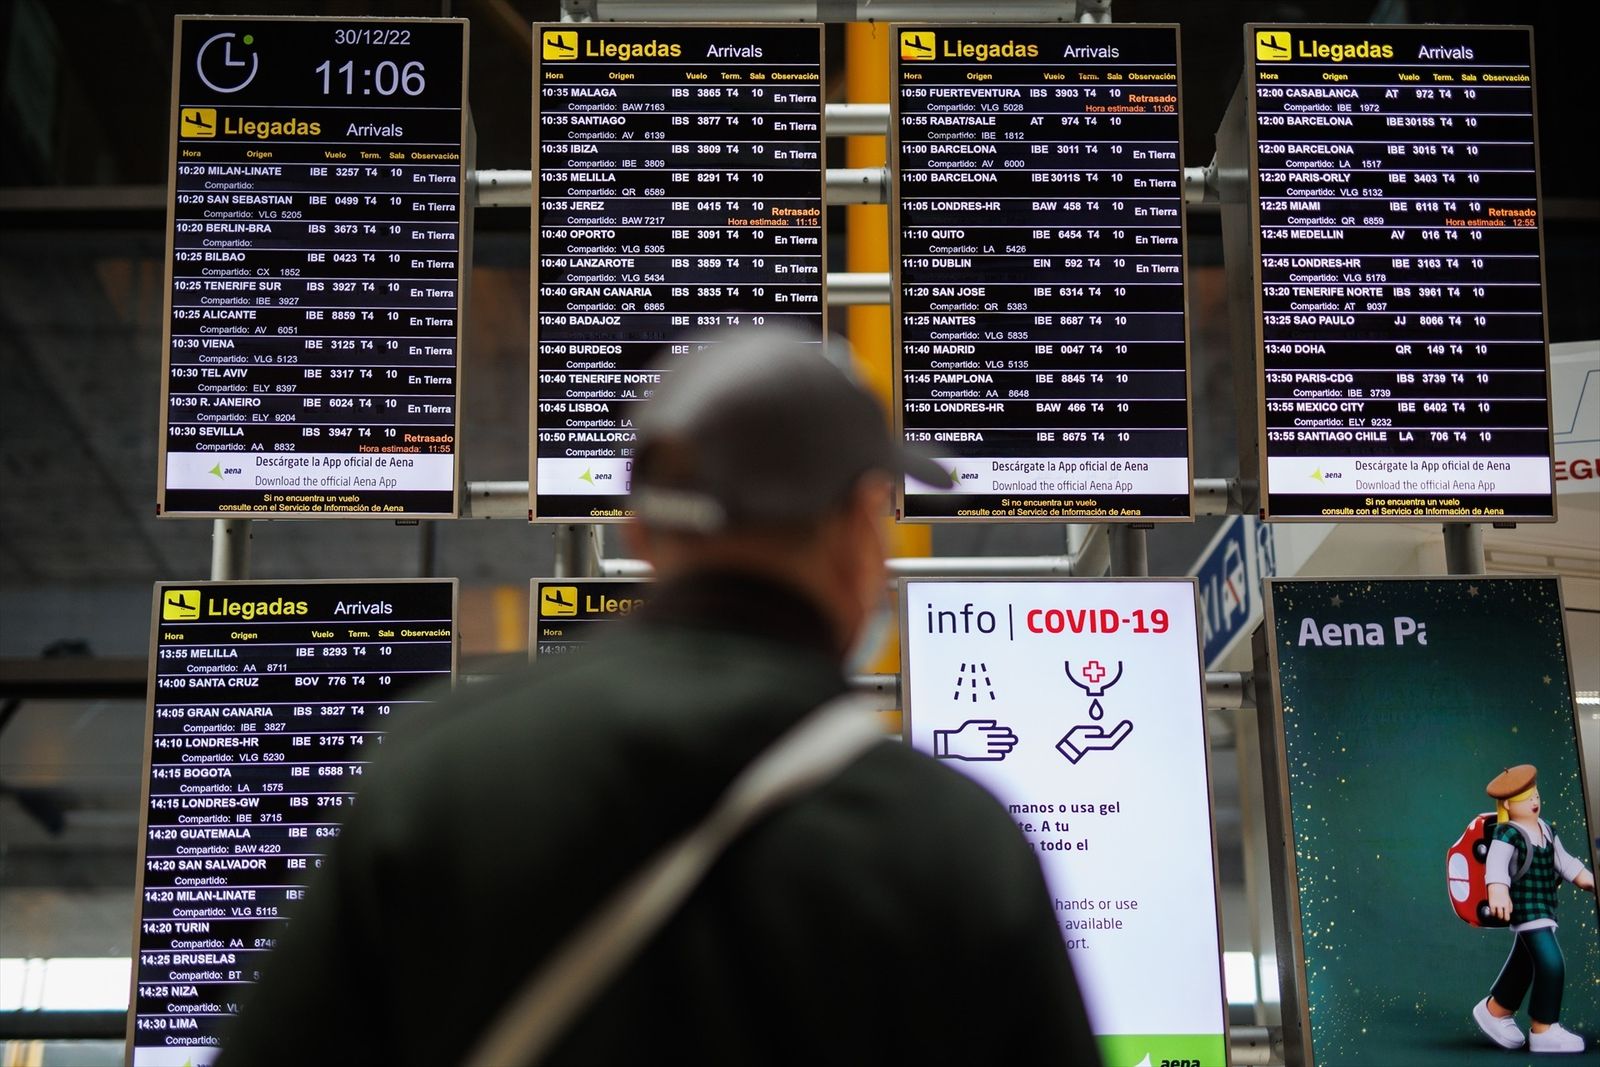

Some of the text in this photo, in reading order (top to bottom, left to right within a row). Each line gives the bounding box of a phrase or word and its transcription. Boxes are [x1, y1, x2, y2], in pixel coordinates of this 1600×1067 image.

[336, 30, 410, 44] 30/12/22
[586, 40, 762, 61] Llegadas Arrivals
[944, 40, 1119, 61] Llegadas Arrivals
[1299, 40, 1474, 62] Llegadas Arrivals
[316, 61, 424, 95] 11:06
[542, 88, 763, 97] 10:35 MALAGA IBS 3865 T4 10
[902, 88, 1121, 97] 10:50 FUERTEVENTURA IBS 3903 T4 10
[1129, 94, 1176, 102] Retrasado
[1257, 88, 1476, 98] 12:00 CASABLANCA AT 972 T4 10
[225, 118, 402, 138] Llegadas Arrivals
[179, 166, 456, 182] 10:20 MILAN-LINATE IBE 3257 T4 10 En Tierra
[178, 195, 402, 205] 10:20 SAN SEBASTIAN IBE 0499 T4 10
[204, 210, 253, 219] Compartido:
[540, 288, 818, 302] 10:40 GRAN CANARIA IBS 3835 T4 10 En Tierra
[1264, 287, 1484, 296] 13:20 TENERIFE NORTE IBS 3961 T4 10
[567, 302, 616, 312] Compartido:
[904, 374, 1128, 383] 11:45 PAMPLONA IBE 8845 T4 10
[931, 390, 980, 398] Compartido:
[169, 426, 396, 437] 10:30 SEVILLA IBS 3947 T4 10
[404, 434, 454, 442] Retrasado
[256, 456, 414, 468] Descárgate la App oficial de Aena
[1553, 458, 1600, 480] EG
[255, 475, 397, 488] Download the official Aena App
[263, 494, 272, 502] Si
[312, 504, 322, 512] de
[324, 504, 370, 512] Información
[371, 504, 381, 512] de
[209, 598, 392, 620] Llegadas Arrivals
[927, 603, 1169, 634] info COVID-19
[1298, 618, 1385, 646] Aena
[160, 646, 392, 658] 13:55 MELILLA IBE 8293 T4 10
[1008, 802, 1120, 815] manos o usa gel
[1042, 821, 1050, 832] A
[1055, 822, 1069, 832] tu
[149, 829, 177, 840] 14:20
[180, 828, 251, 839] GUATEMALA
[288, 828, 308, 838] IBE
[1040, 839, 1072, 851] todo
[1076, 839, 1088, 850] el
[1056, 898, 1138, 910] hands or use
[1065, 918, 1123, 930] available
[137, 1017, 198, 1030] 14:30 LIMA
